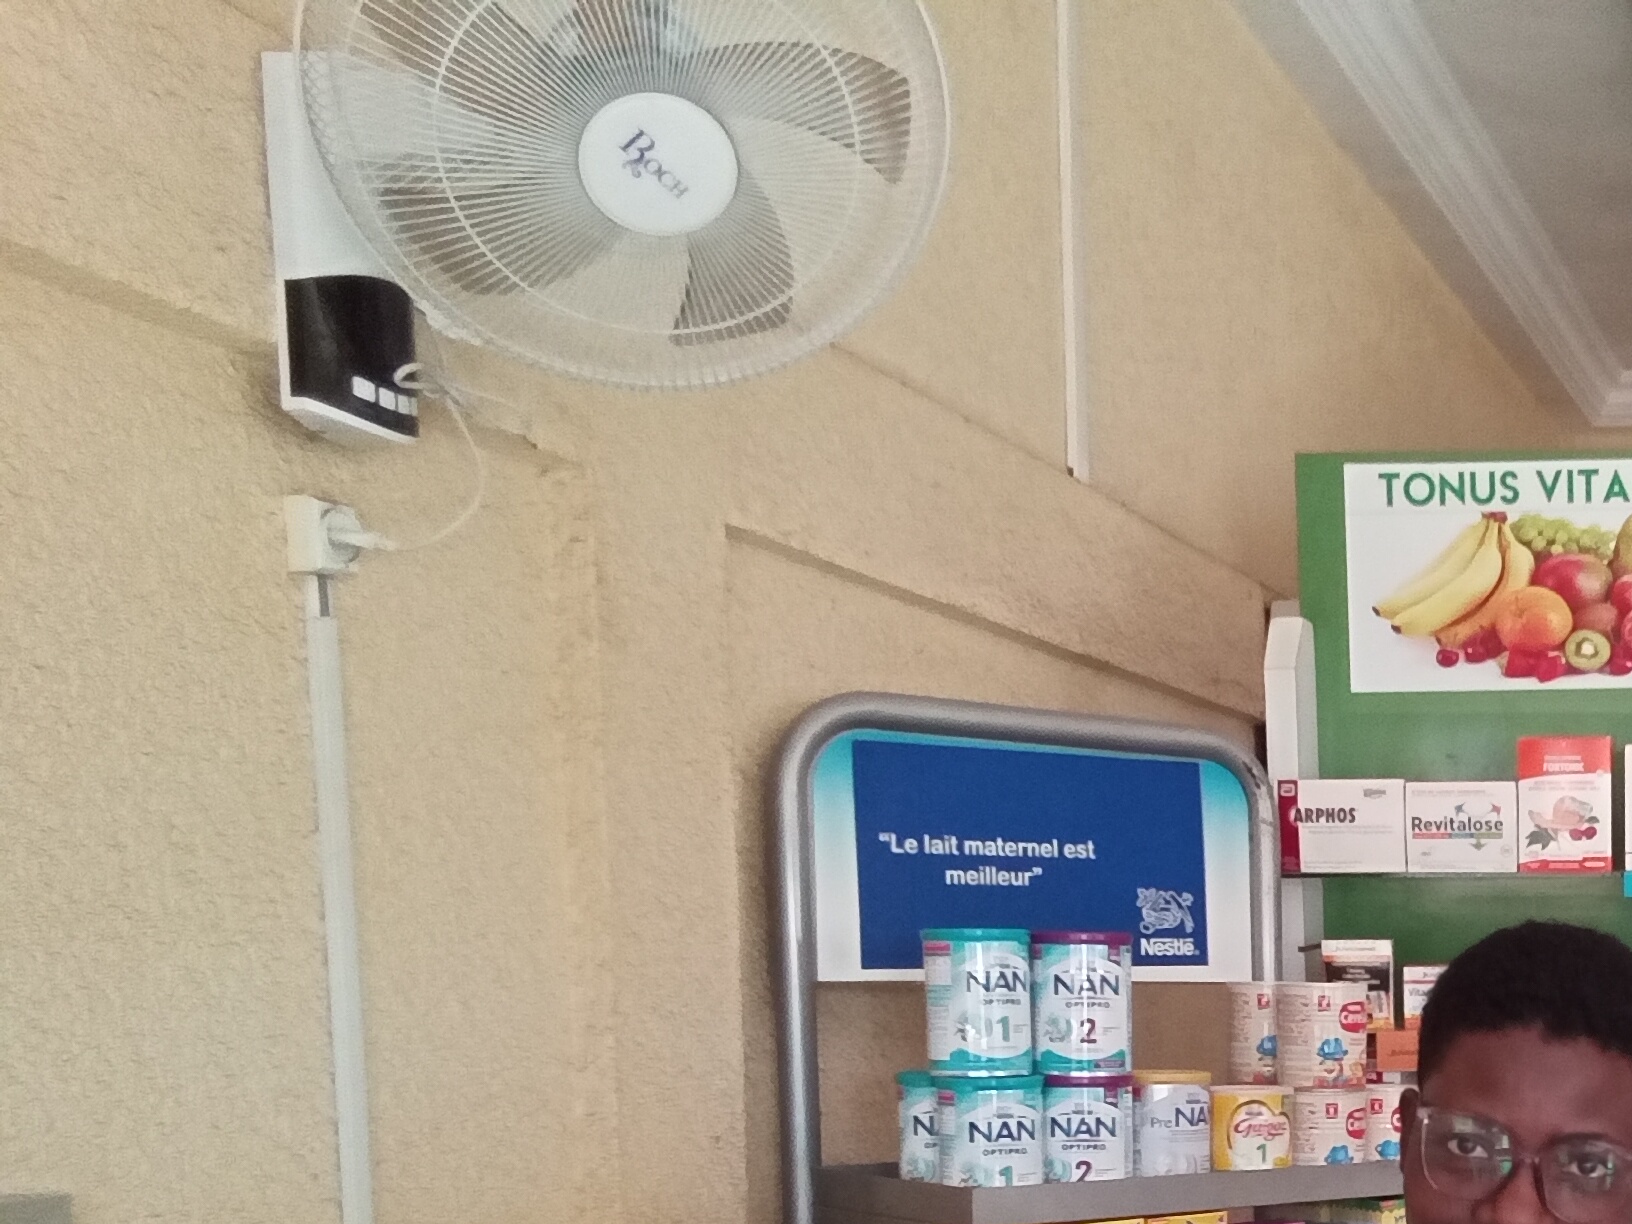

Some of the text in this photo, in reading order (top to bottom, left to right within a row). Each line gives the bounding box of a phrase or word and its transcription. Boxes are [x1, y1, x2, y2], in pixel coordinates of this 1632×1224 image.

[1378, 471, 1521, 508] TONUS
[1411, 815, 1504, 832] Revitalose
[924, 834, 959, 856] lait
[963, 837, 1058, 859] maternel
[1063, 840, 1096, 860] est
[966, 970, 1027, 993] NAN
[1053, 973, 1120, 996] NAN
[996, 1015, 1011, 1043] 1
[1079, 1018, 1098, 1044] 2
[968, 1119, 1036, 1143] NAN
[1050, 1116, 1117, 1138] NAN
[982, 1147, 1028, 1157] OPTIPRO
[1061, 1143, 1107, 1152] OPTIPRO
